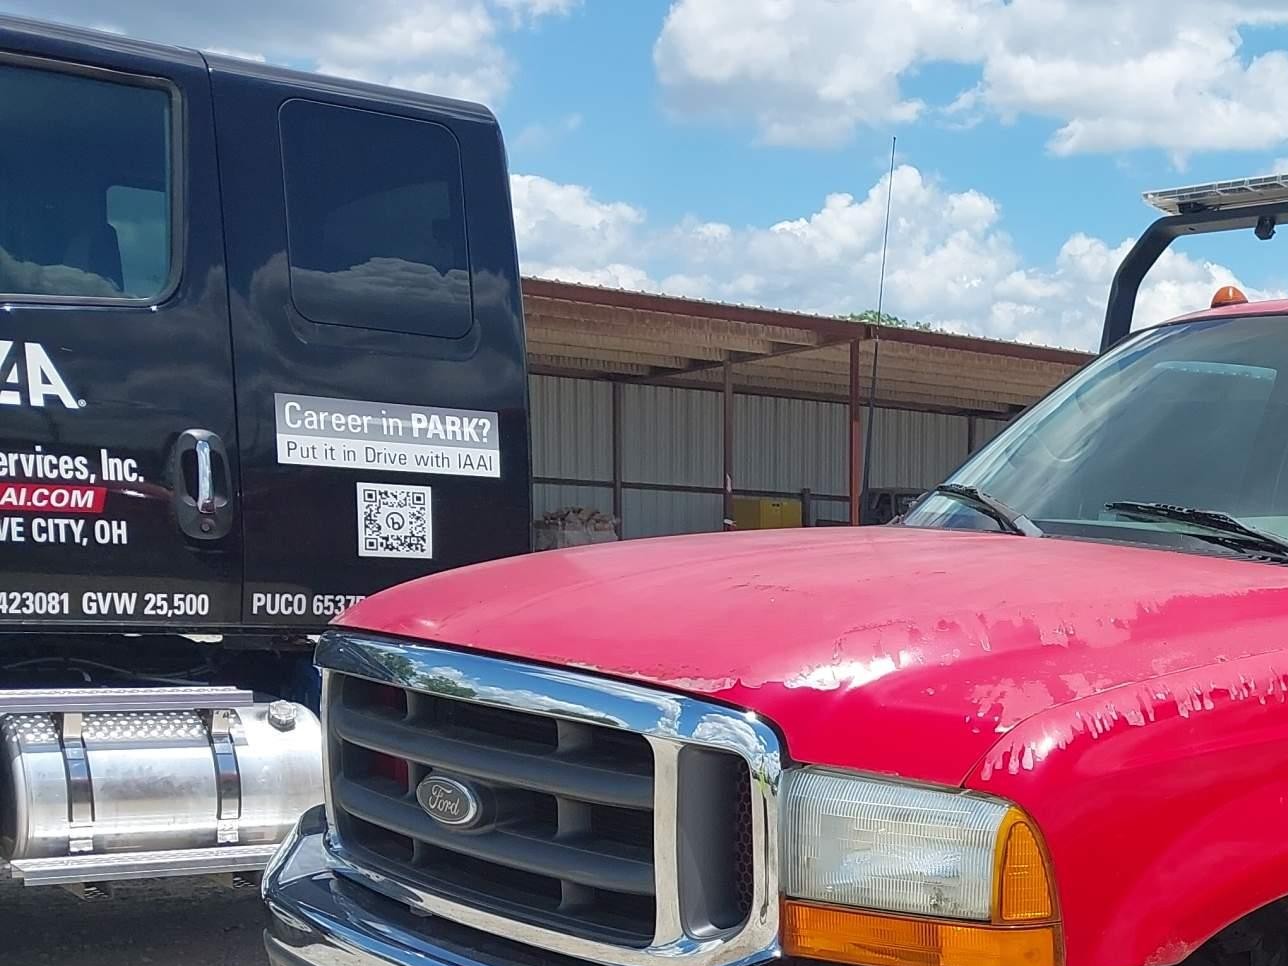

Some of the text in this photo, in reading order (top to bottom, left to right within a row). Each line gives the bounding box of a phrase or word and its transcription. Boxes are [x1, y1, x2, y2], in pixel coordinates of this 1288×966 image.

[284, 401, 491, 443] Career in PARK?
[100, 448, 144, 482] Inc.
[286, 440, 493, 471] Put it in Drive with IAAI
[31, 517, 88, 546] CITY,
[94, 520, 127, 544] OH
[82, 592, 137, 615] GVW
[143, 593, 209, 617] 25,500
[252, 593, 306, 615] PUCO
[428, 784, 460, 816] Ford
